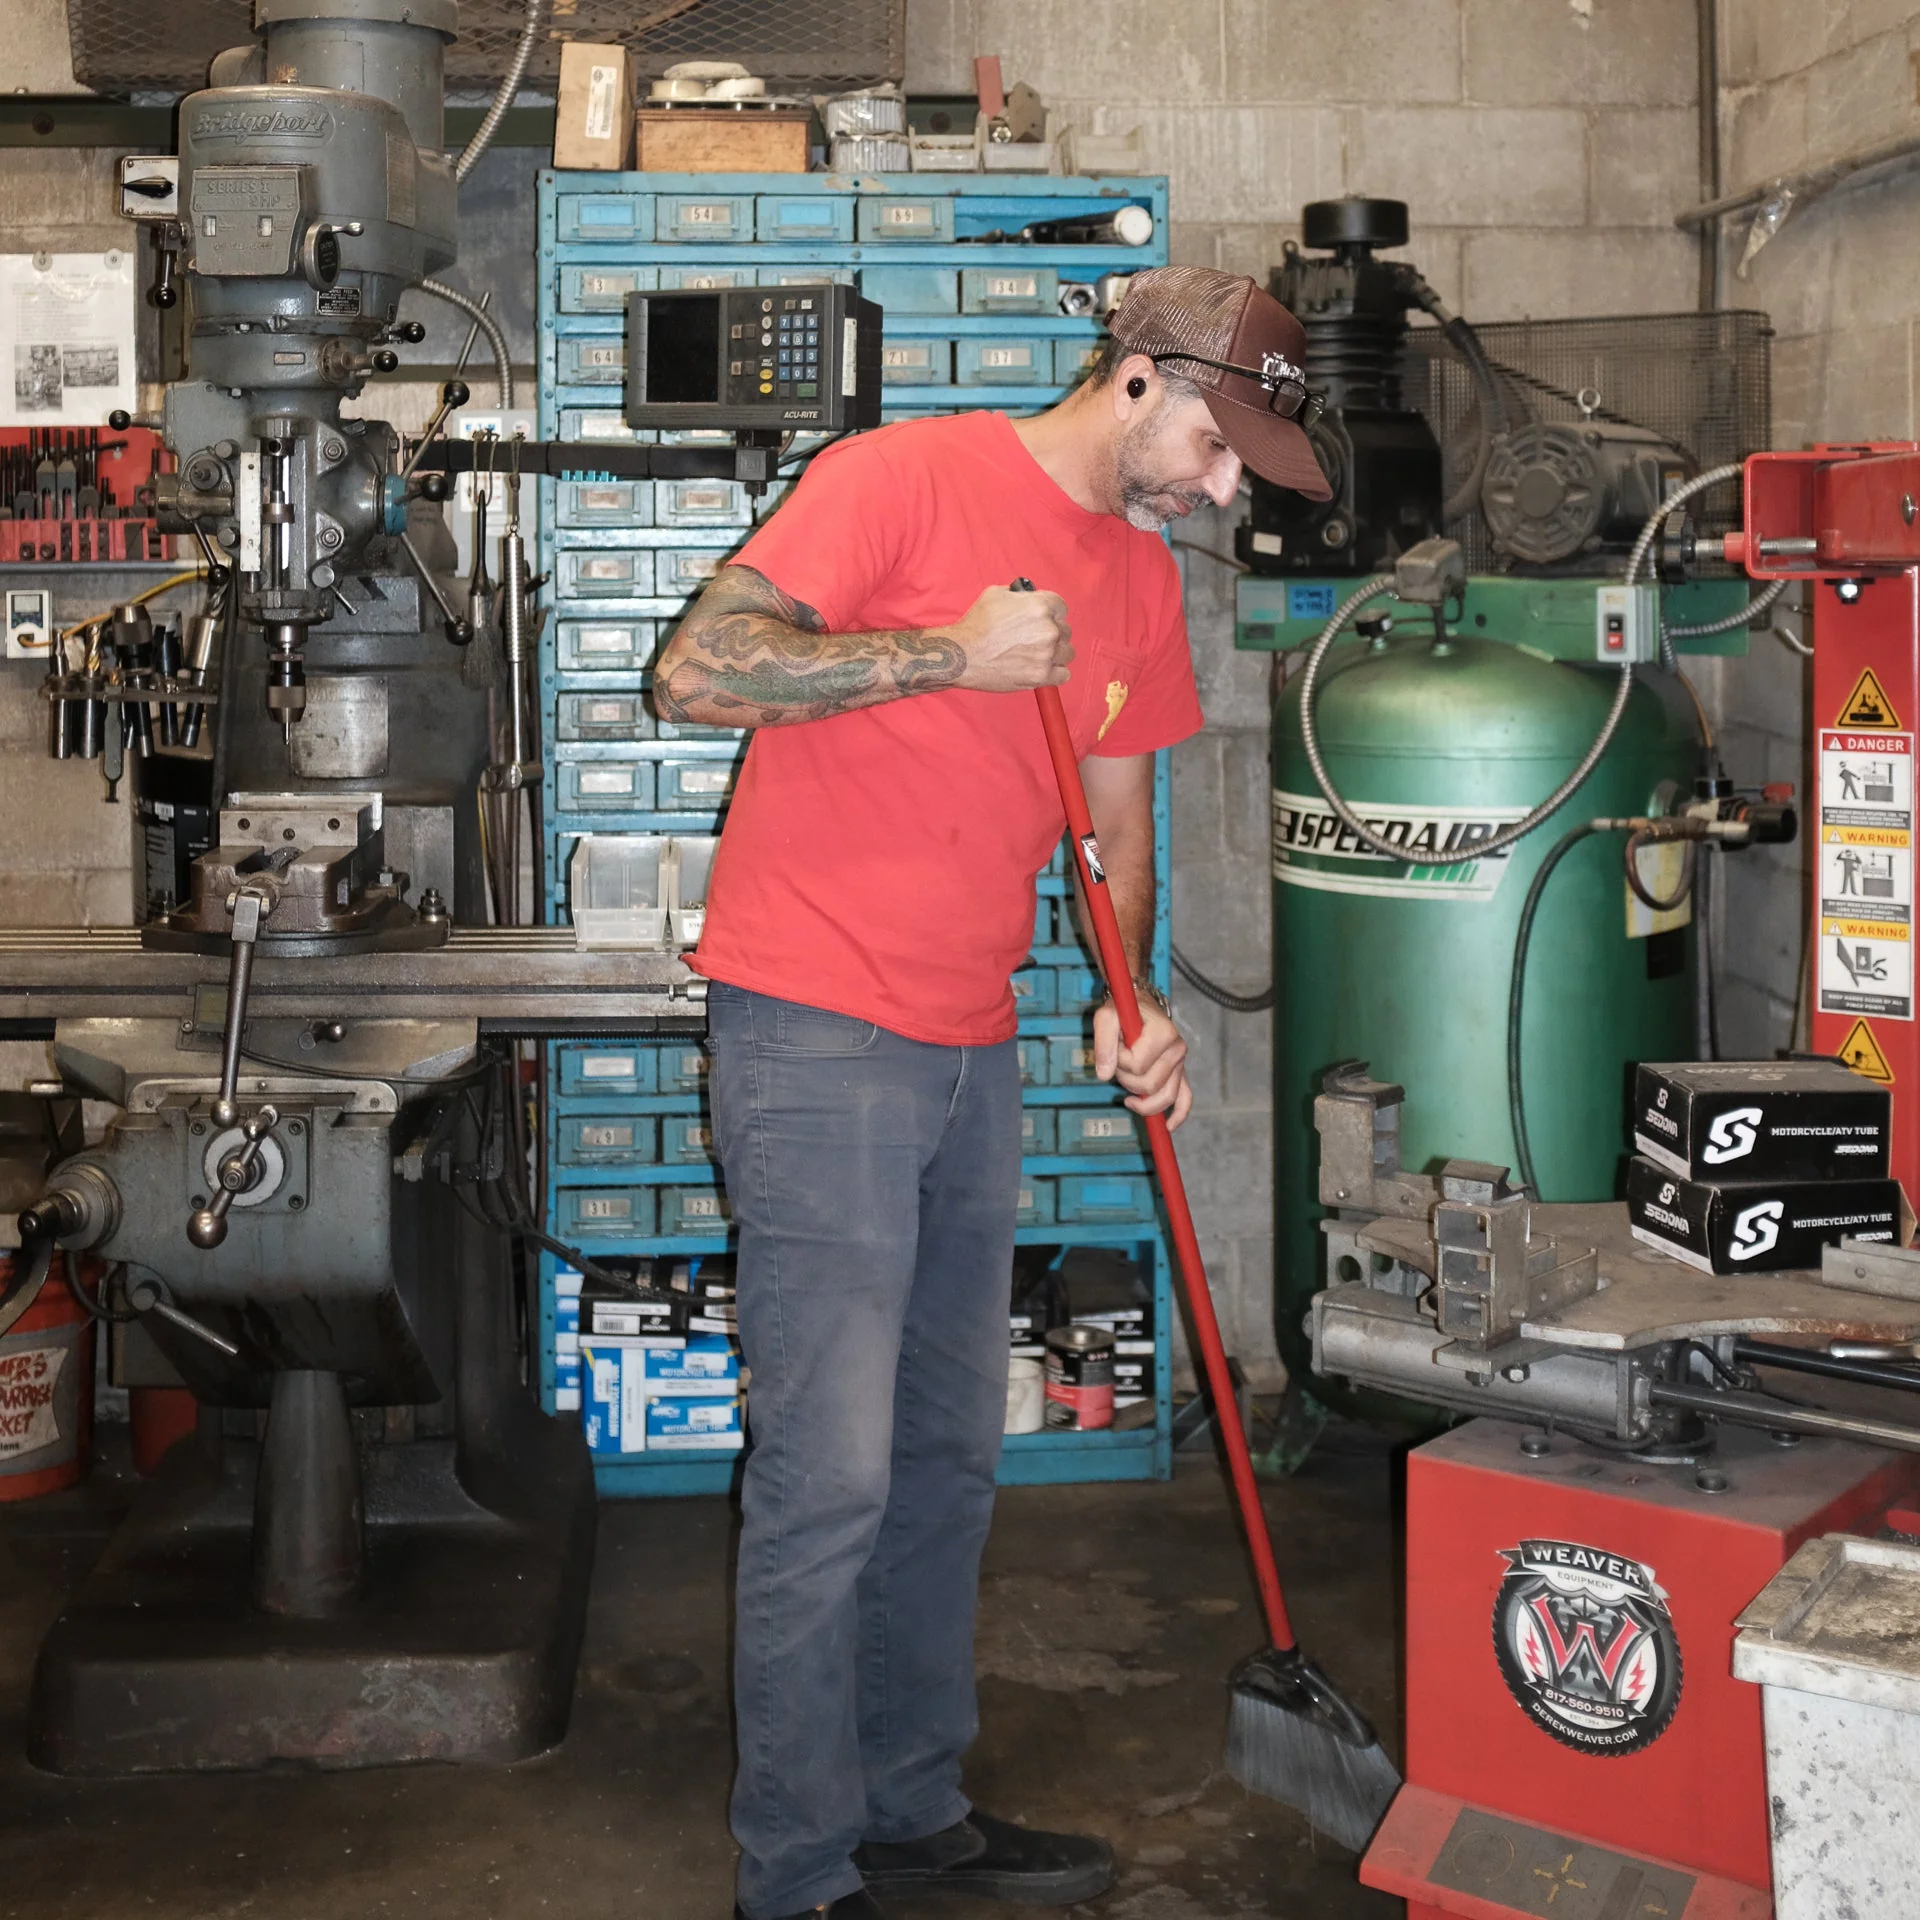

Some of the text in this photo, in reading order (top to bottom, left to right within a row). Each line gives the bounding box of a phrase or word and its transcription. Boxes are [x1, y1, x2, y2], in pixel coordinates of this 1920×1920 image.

[207, 181, 257, 194] SERIES
[693, 207, 711, 220] 54
[999, 281, 1015, 294] 34
[594, 351, 612, 365] 64
[784, 410, 819, 419] ACU-RITE
[1847, 737, 1905, 752] DANGER
[1847, 832, 1908, 846] WARNING
[1846, 924, 1907, 939] WARNING
[1645, 1108, 1678, 1138] SEDONA
[1771, 1127, 1880, 1136] MOTORCYCLE/ATV TUBE
[1834, 1145, 1878, 1153] SEDONA
[1644, 1202, 1690, 1234] SEDONA
[1792, 1213, 1893, 1229] MOTORCYCLE/ATV TUBE
[1531, 1546, 1642, 1585] WEAVER
[1557, 1571, 1615, 1591] EQUIPMENT
[1545, 1688, 1625, 1719] 817-560-9510
[1531, 1702, 1639, 1745] DEREKWEAVER.COM
